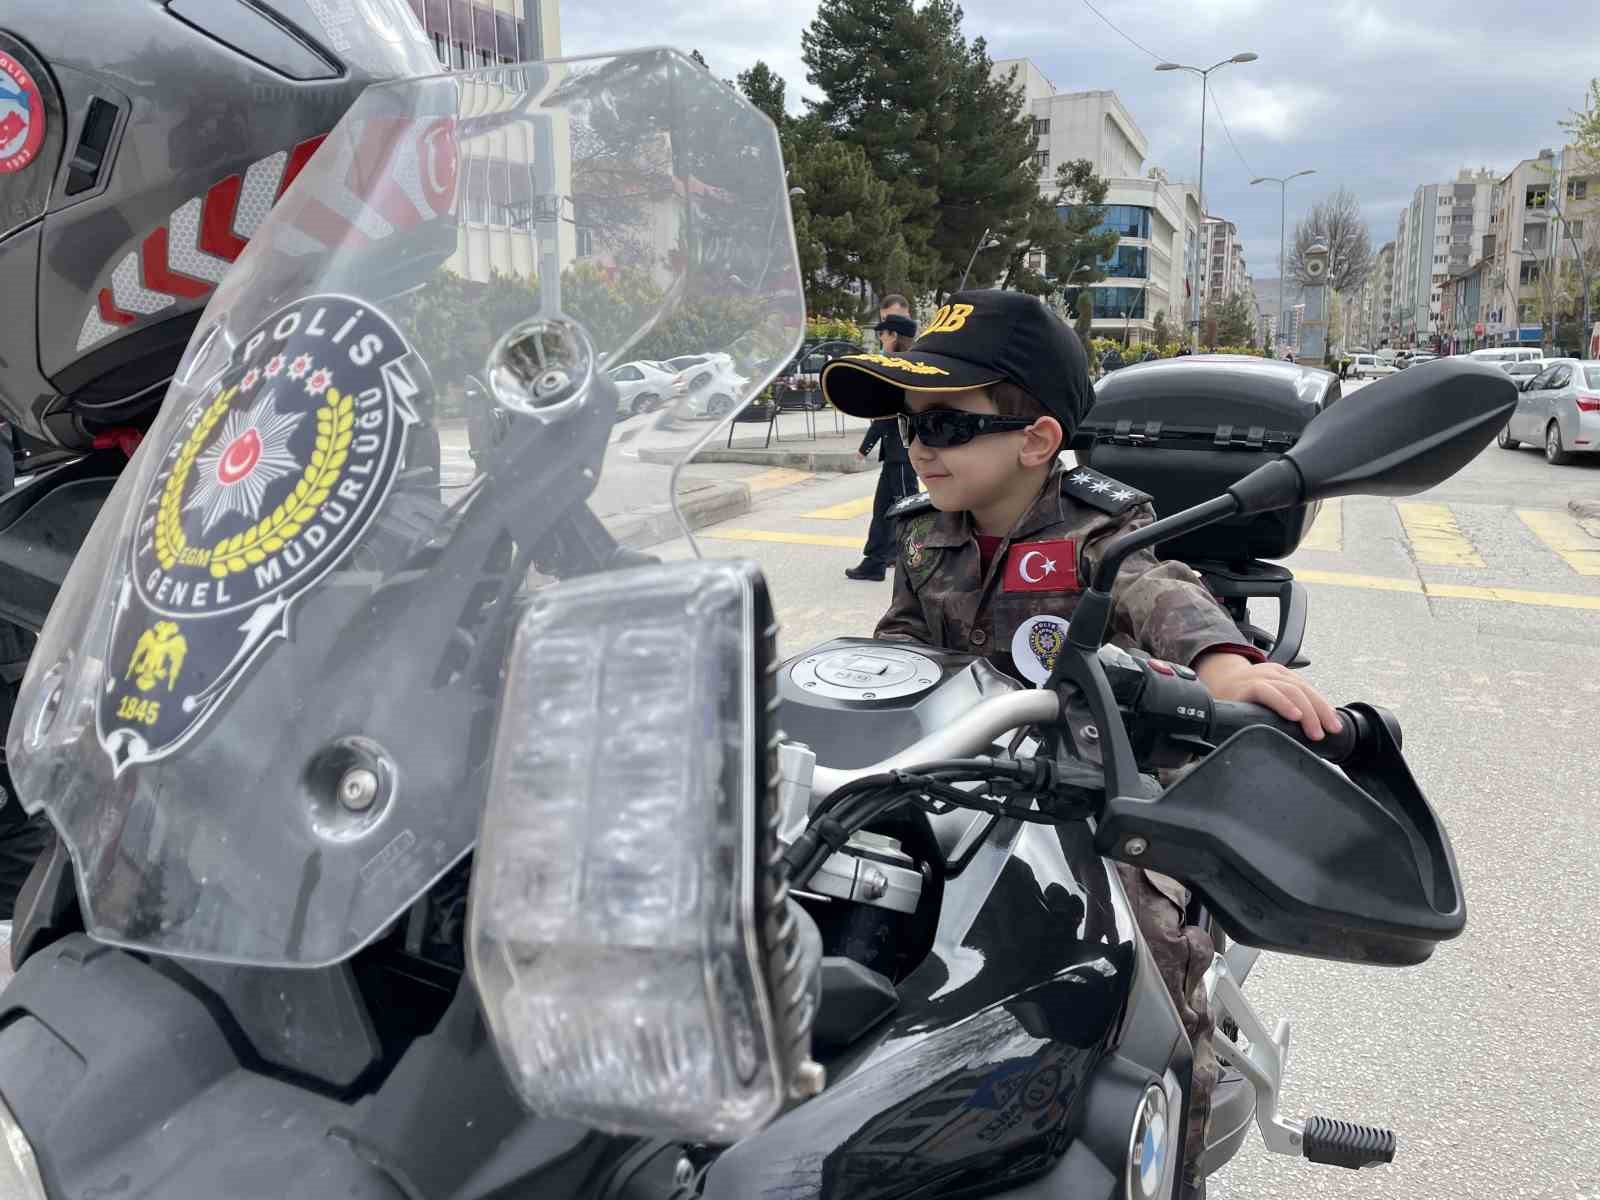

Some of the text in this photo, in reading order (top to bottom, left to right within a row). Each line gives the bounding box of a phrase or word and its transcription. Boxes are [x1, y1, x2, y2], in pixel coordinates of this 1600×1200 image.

[243, 308, 384, 361] POLİS
[145, 567, 231, 607] GENEL
[254, 387, 384, 589] MÜDÜRLÜĞÜ
[177, 547, 211, 567] EGM
[116, 695, 160, 725] 1845
